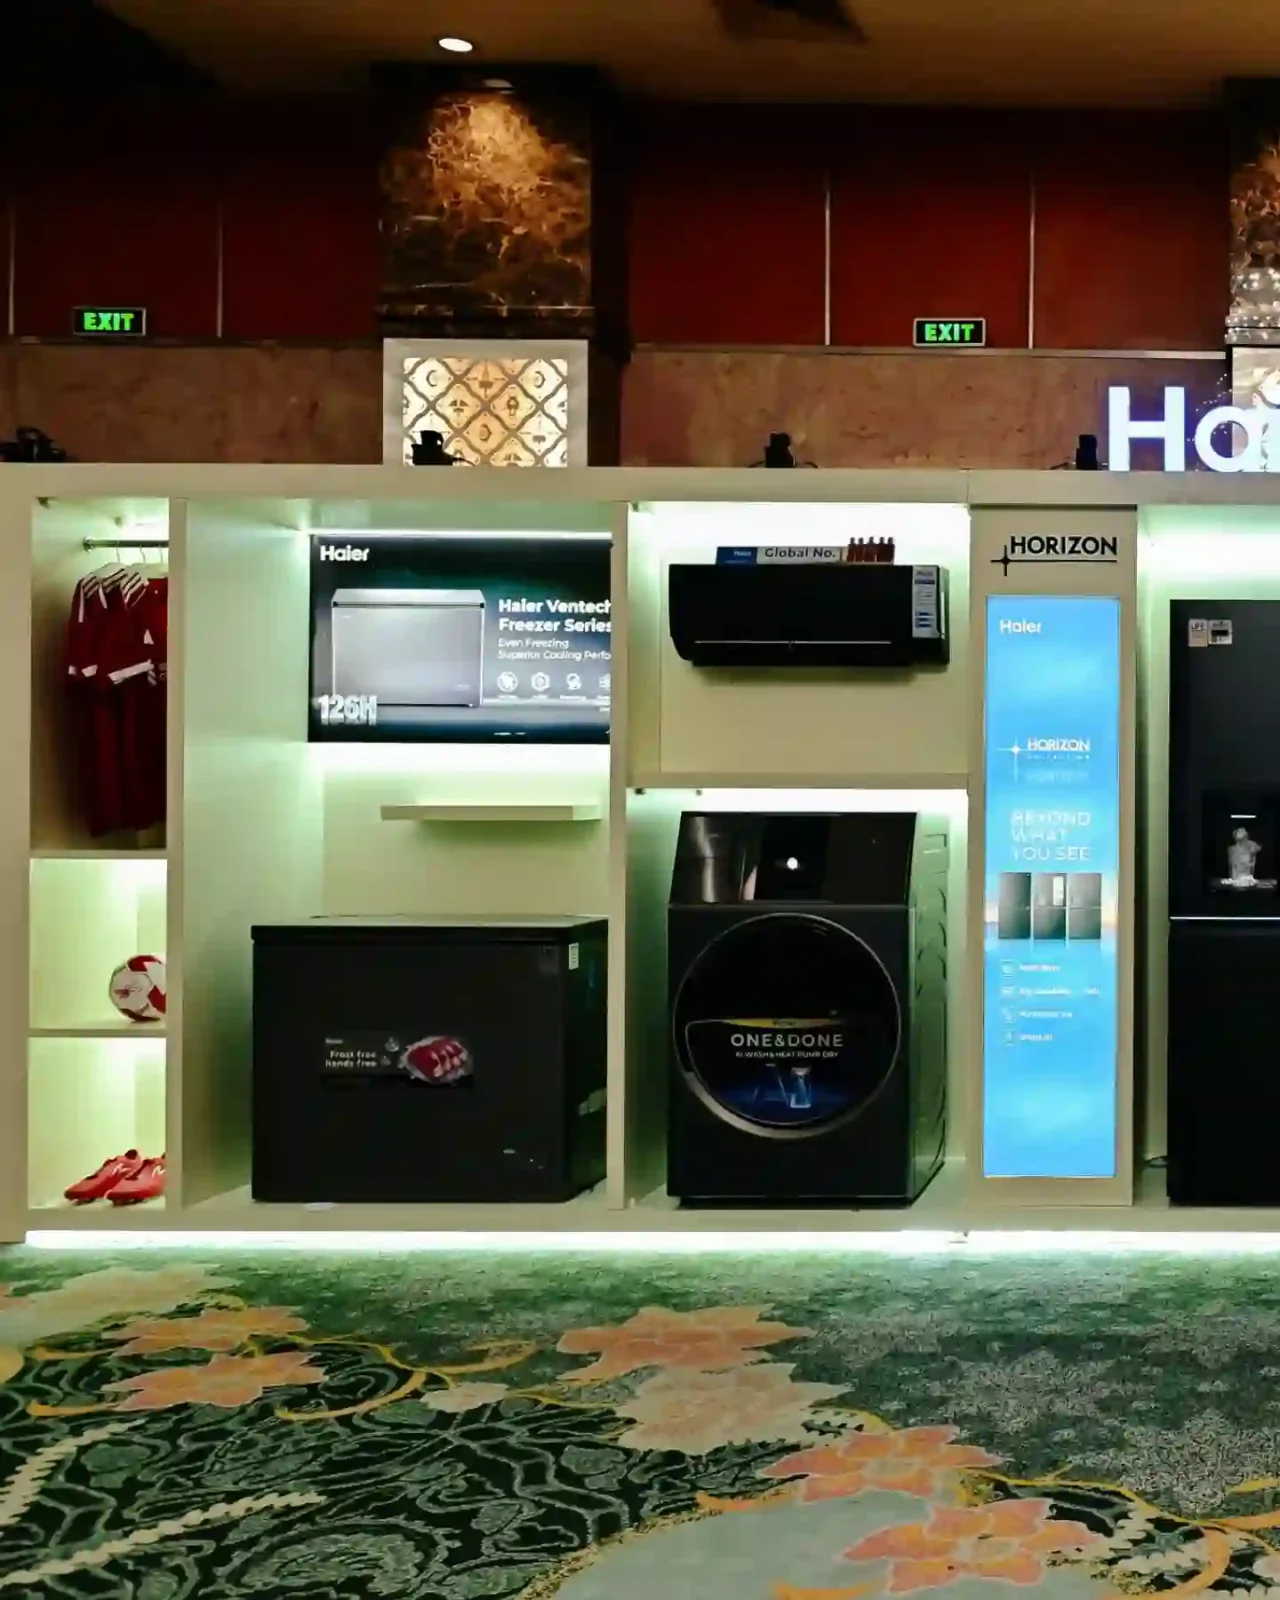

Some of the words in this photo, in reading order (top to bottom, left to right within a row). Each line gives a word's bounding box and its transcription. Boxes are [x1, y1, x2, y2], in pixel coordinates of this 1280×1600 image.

[83, 312, 135, 331] EXIT
[924, 323, 975, 342] EXIT
[764, 547, 809, 559] Global
[812, 548, 836, 559] No.
[1010, 535, 1118, 556] HORIZON
[319, 545, 370, 562] Haier
[498, 599, 544, 613] Haier
[546, 599, 612, 613] Ventech
[499, 618, 561, 632] Freezer
[564, 618, 612, 632] Series
[999, 619, 1042, 634] Haier
[498, 638, 523, 648] Even
[526, 638, 570, 650] Freezing
[498, 649, 540, 661] Superior
[543, 650, 582, 662] Cooling
[584, 650, 612, 661] Perfo
[318, 694, 378, 726] 126H
[1027, 738, 1091, 751] HORIZON
[1011, 809, 1091, 826] BEYOND
[1012, 828, 1068, 843] WHAT
[1012, 846, 1050, 861] YOU
[1056, 846, 1090, 861] SEE
[730, 1033, 844, 1048] ONE&DONE
[330, 1050, 354, 1059] Frost
[356, 1050, 377, 1059] free
[325, 1059, 354, 1068] hands
[356, 1059, 378, 1068] free
